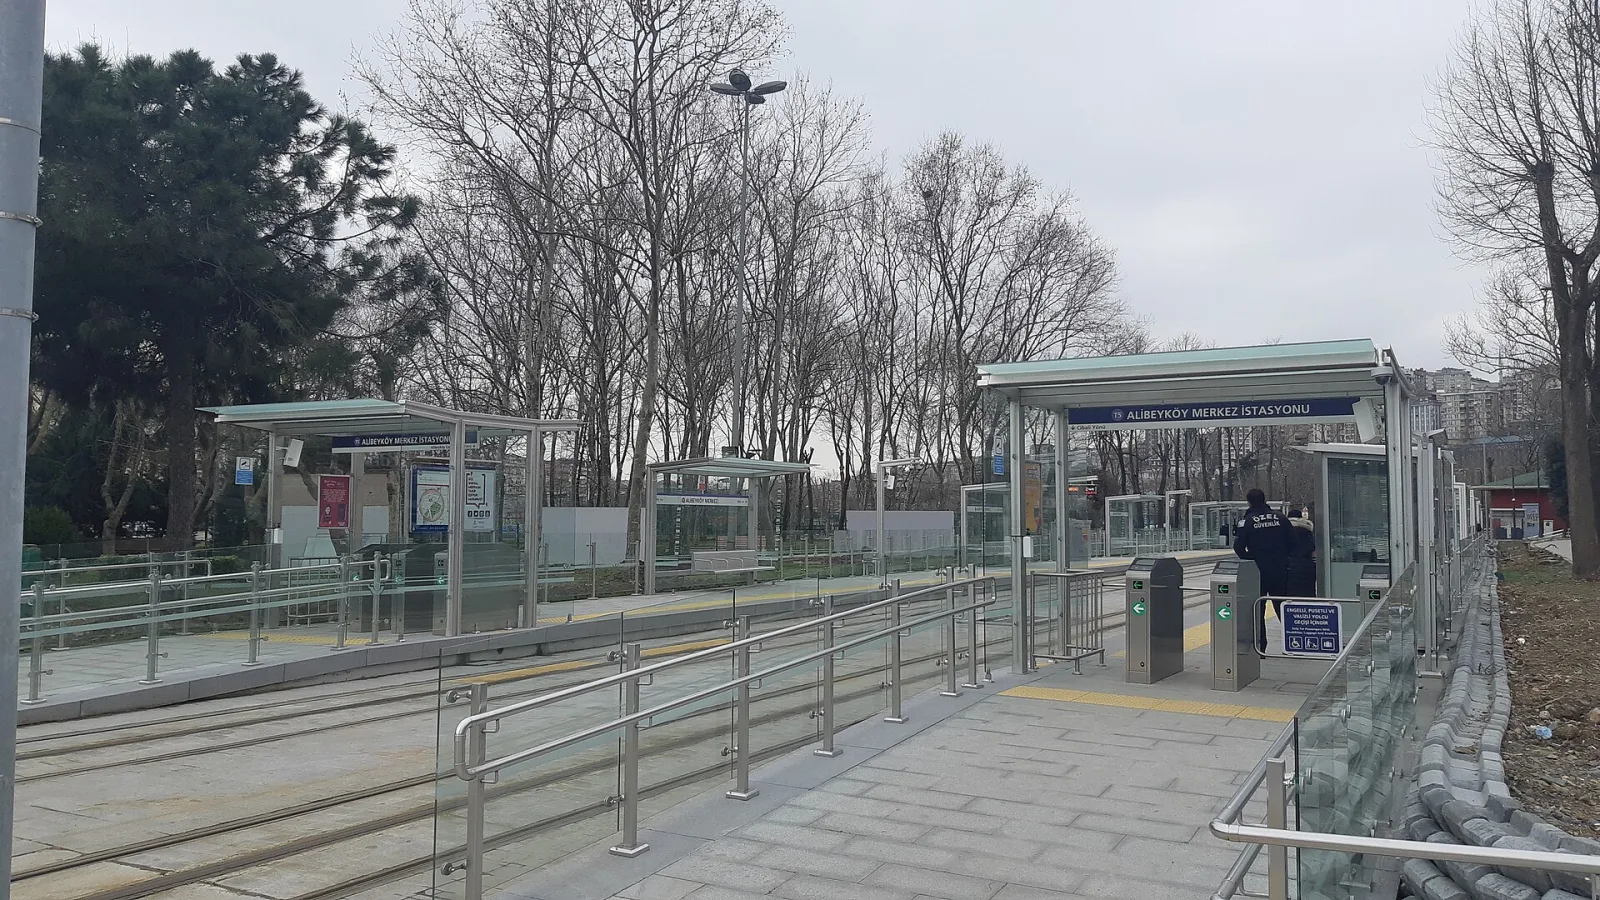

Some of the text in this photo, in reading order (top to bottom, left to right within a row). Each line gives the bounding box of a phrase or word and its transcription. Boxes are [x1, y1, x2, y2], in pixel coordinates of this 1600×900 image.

[1127, 407, 1189, 420] ALİBEYKÖY
[1192, 406, 1239, 418] MERKEZ
[1241, 404, 1311, 416] İSTASYONU
[361, 437, 393, 445] ALİBEYKÖY
[394, 436, 418, 444] MERKEZ
[418, 435, 450, 444] İSTASYON
[1252, 514, 1279, 522] ÖZEL
[1253, 520, 1281, 529] GÜVENLİK
